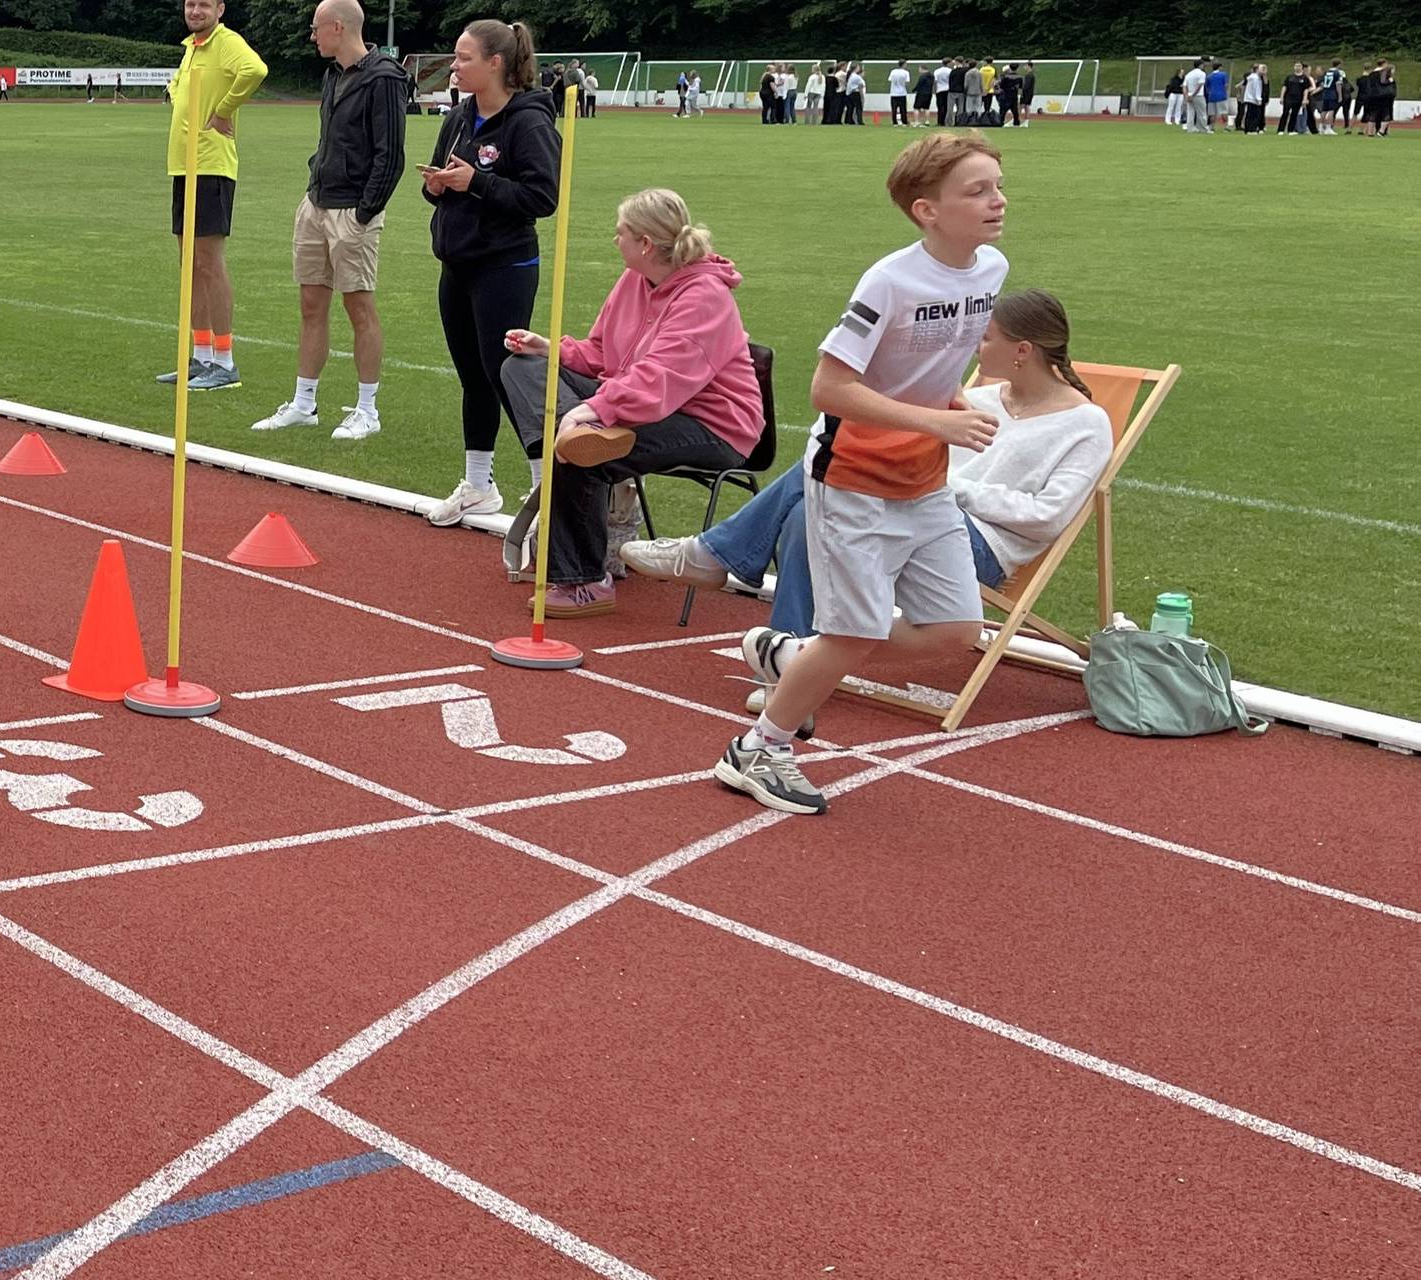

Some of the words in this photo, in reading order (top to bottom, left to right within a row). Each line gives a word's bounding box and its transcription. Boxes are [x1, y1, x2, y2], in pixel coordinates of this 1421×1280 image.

[30, 70, 71, 78] PROTIME
[1323, 75, 1334, 88] 17
[915, 301, 960, 322] new
